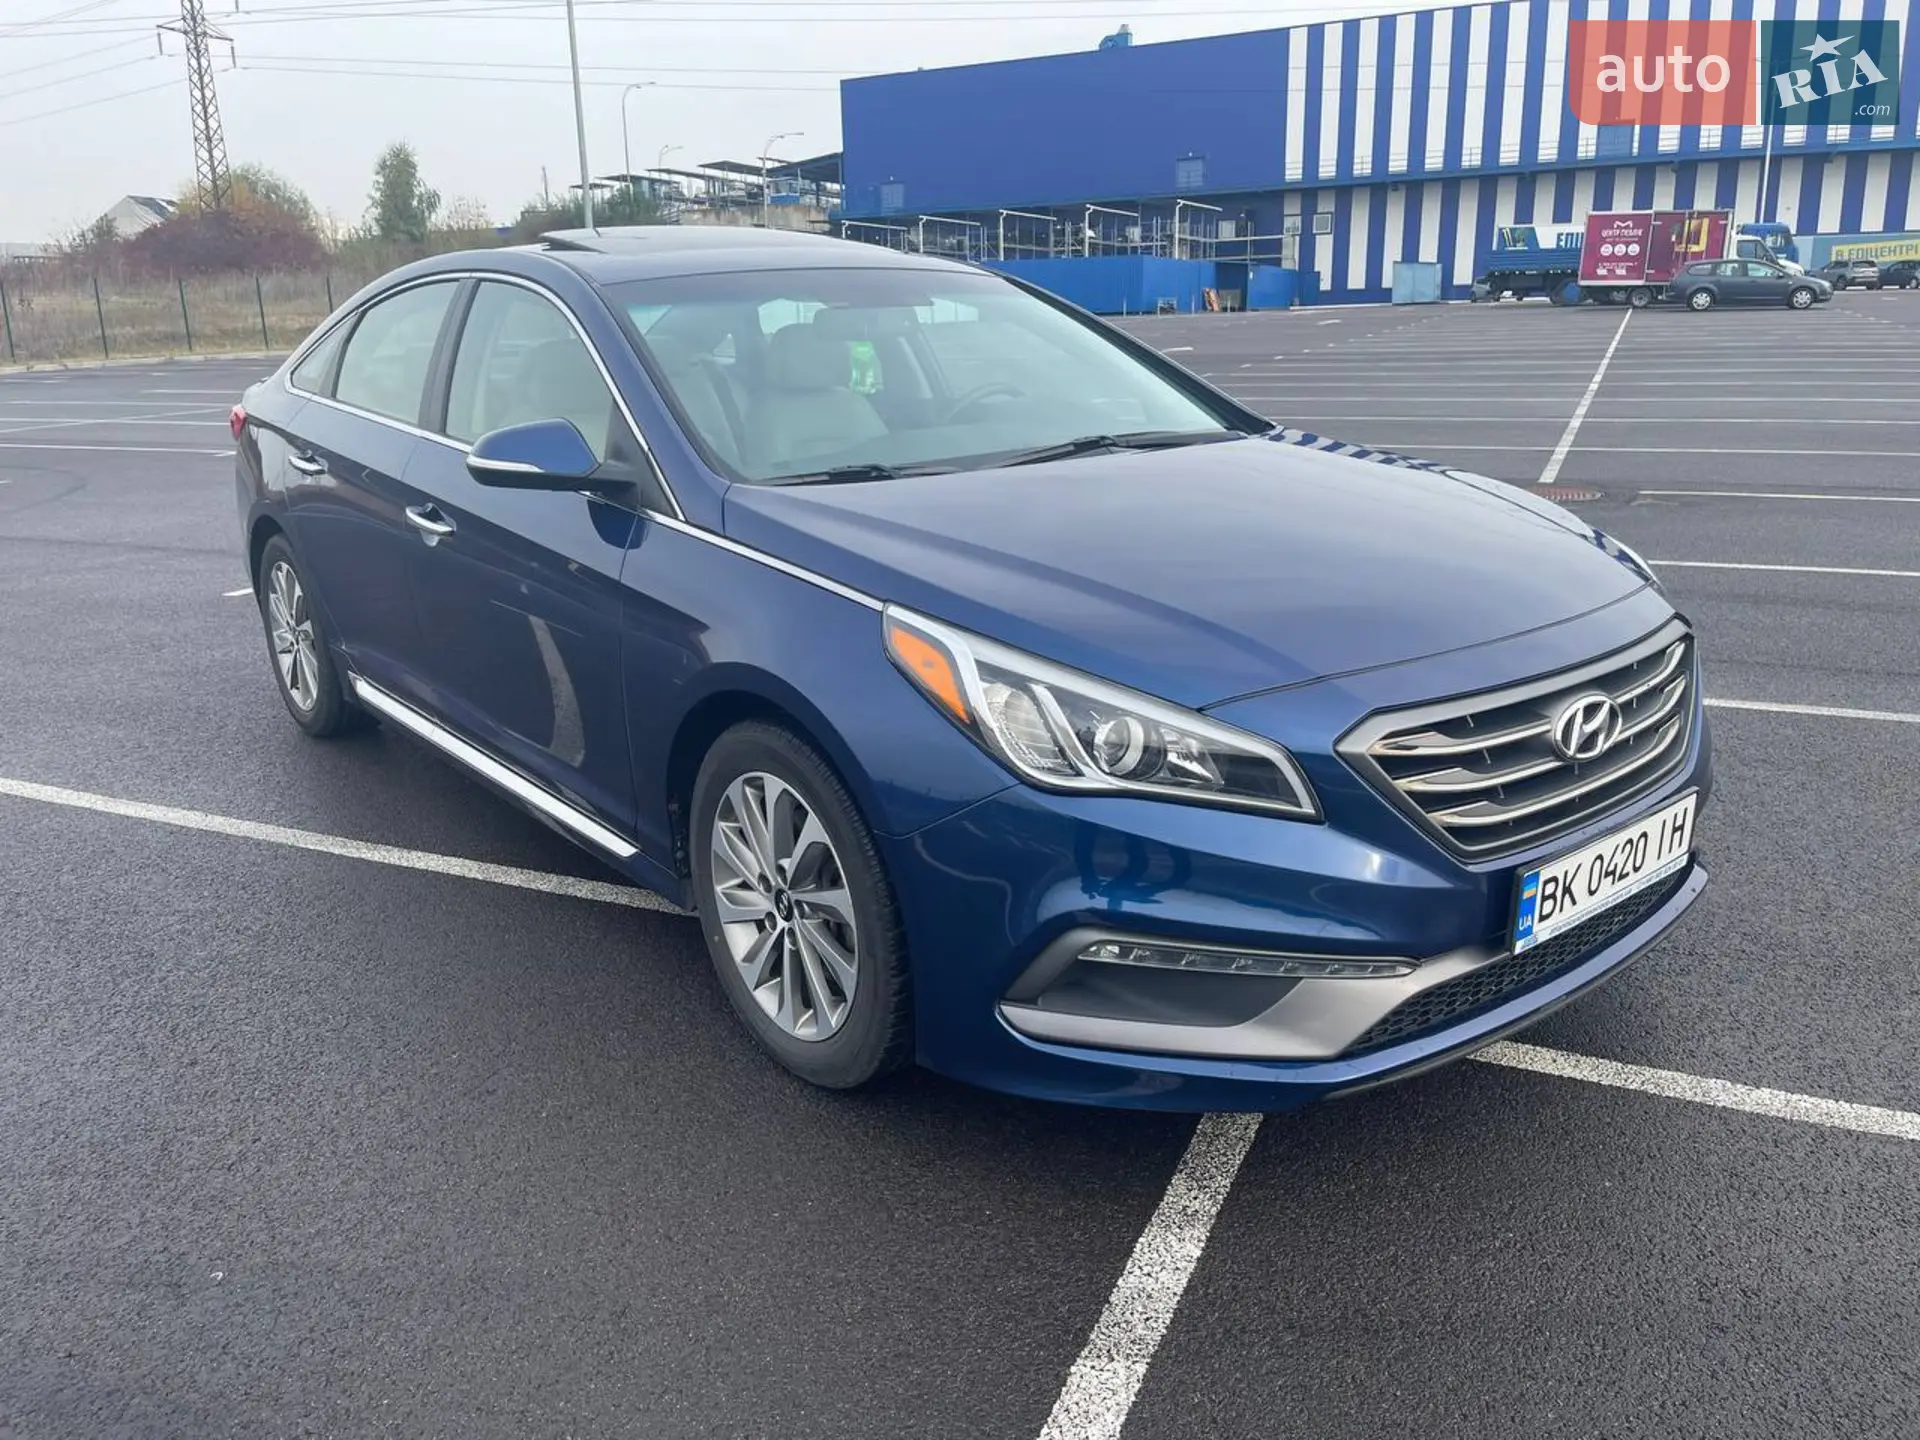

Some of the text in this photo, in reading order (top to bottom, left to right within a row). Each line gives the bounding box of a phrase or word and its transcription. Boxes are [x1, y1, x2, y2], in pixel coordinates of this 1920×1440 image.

[1537, 863, 1582, 924] BK
[1587, 830, 1649, 897] 0420
[1656, 806, 1688, 861] IH
[1518, 915, 1533, 931] UA
